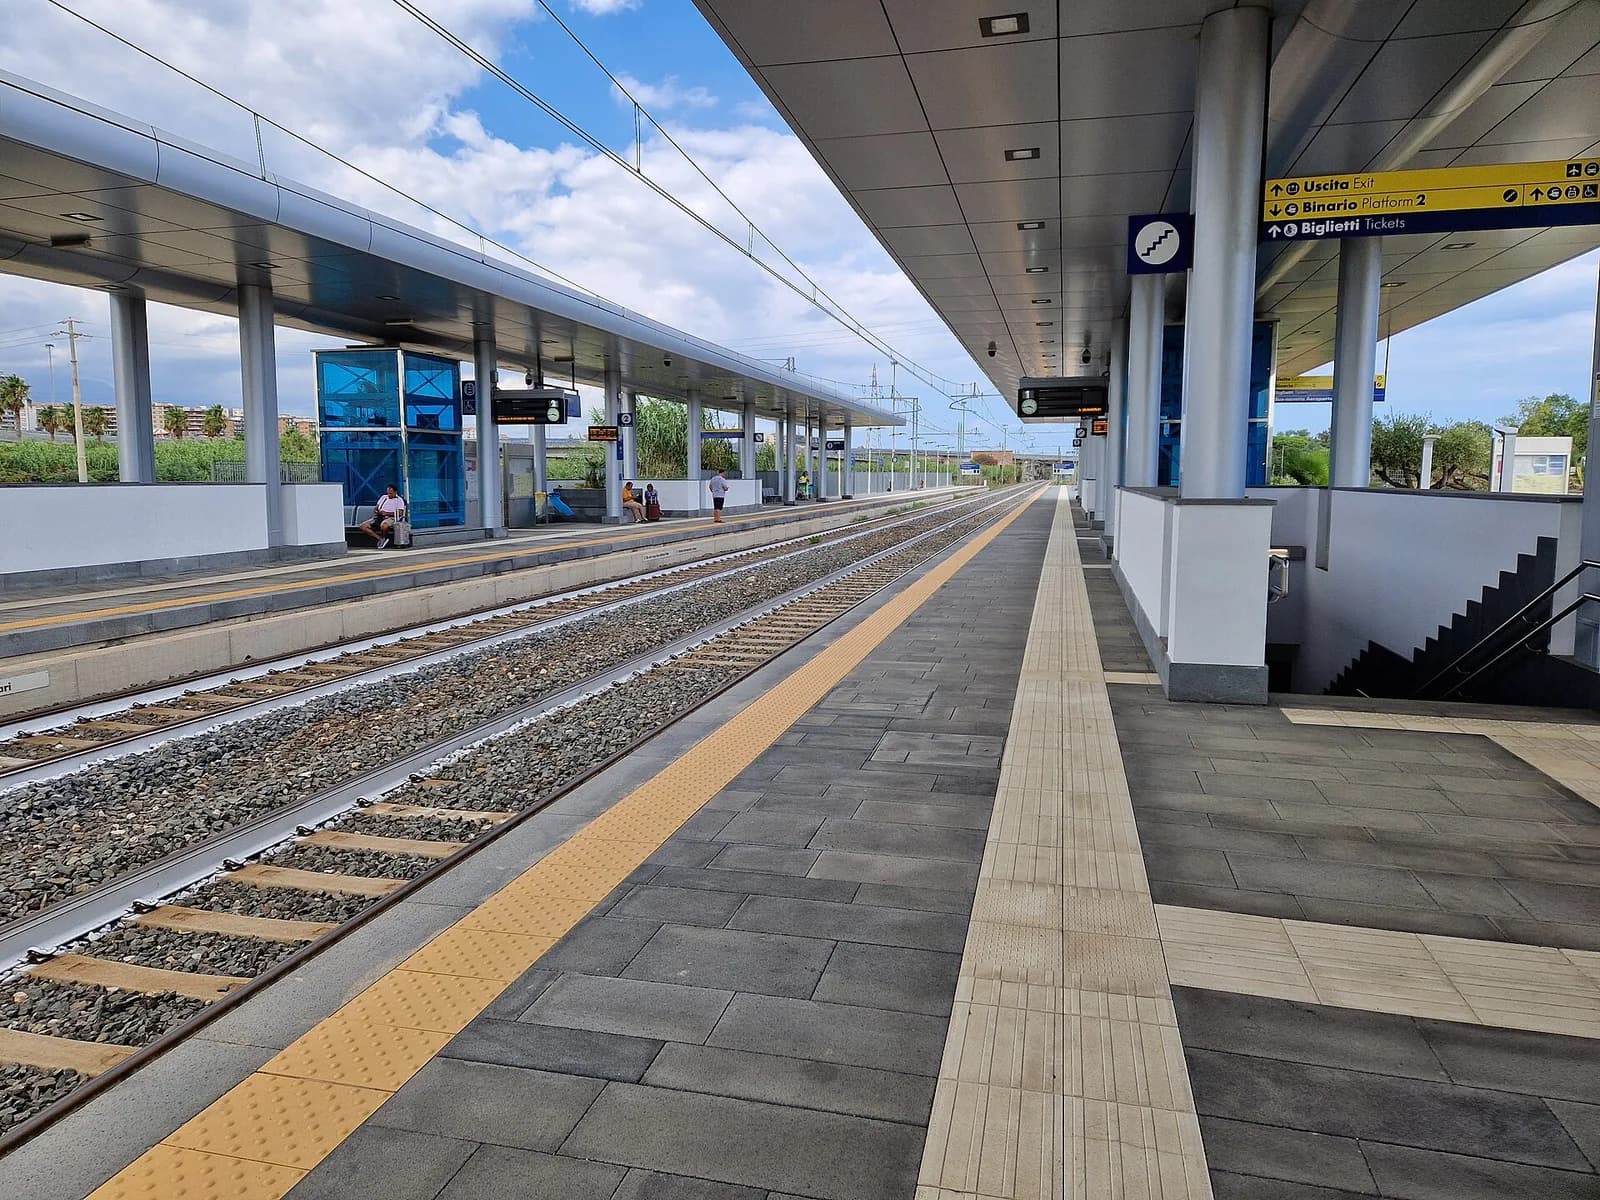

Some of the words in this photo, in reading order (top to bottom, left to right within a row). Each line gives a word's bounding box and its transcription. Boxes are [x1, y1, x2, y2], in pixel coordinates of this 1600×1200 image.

[1304, 180, 1349, 192] Uscita
[1353, 177, 1375, 189] Exit
[1302, 199, 1358, 213] Binario
[1362, 195, 1413, 209] Platform
[1416, 194, 1426, 206] 2
[1301, 219, 1360, 236] Biglietti
[1364, 216, 1405, 230] Tickets
